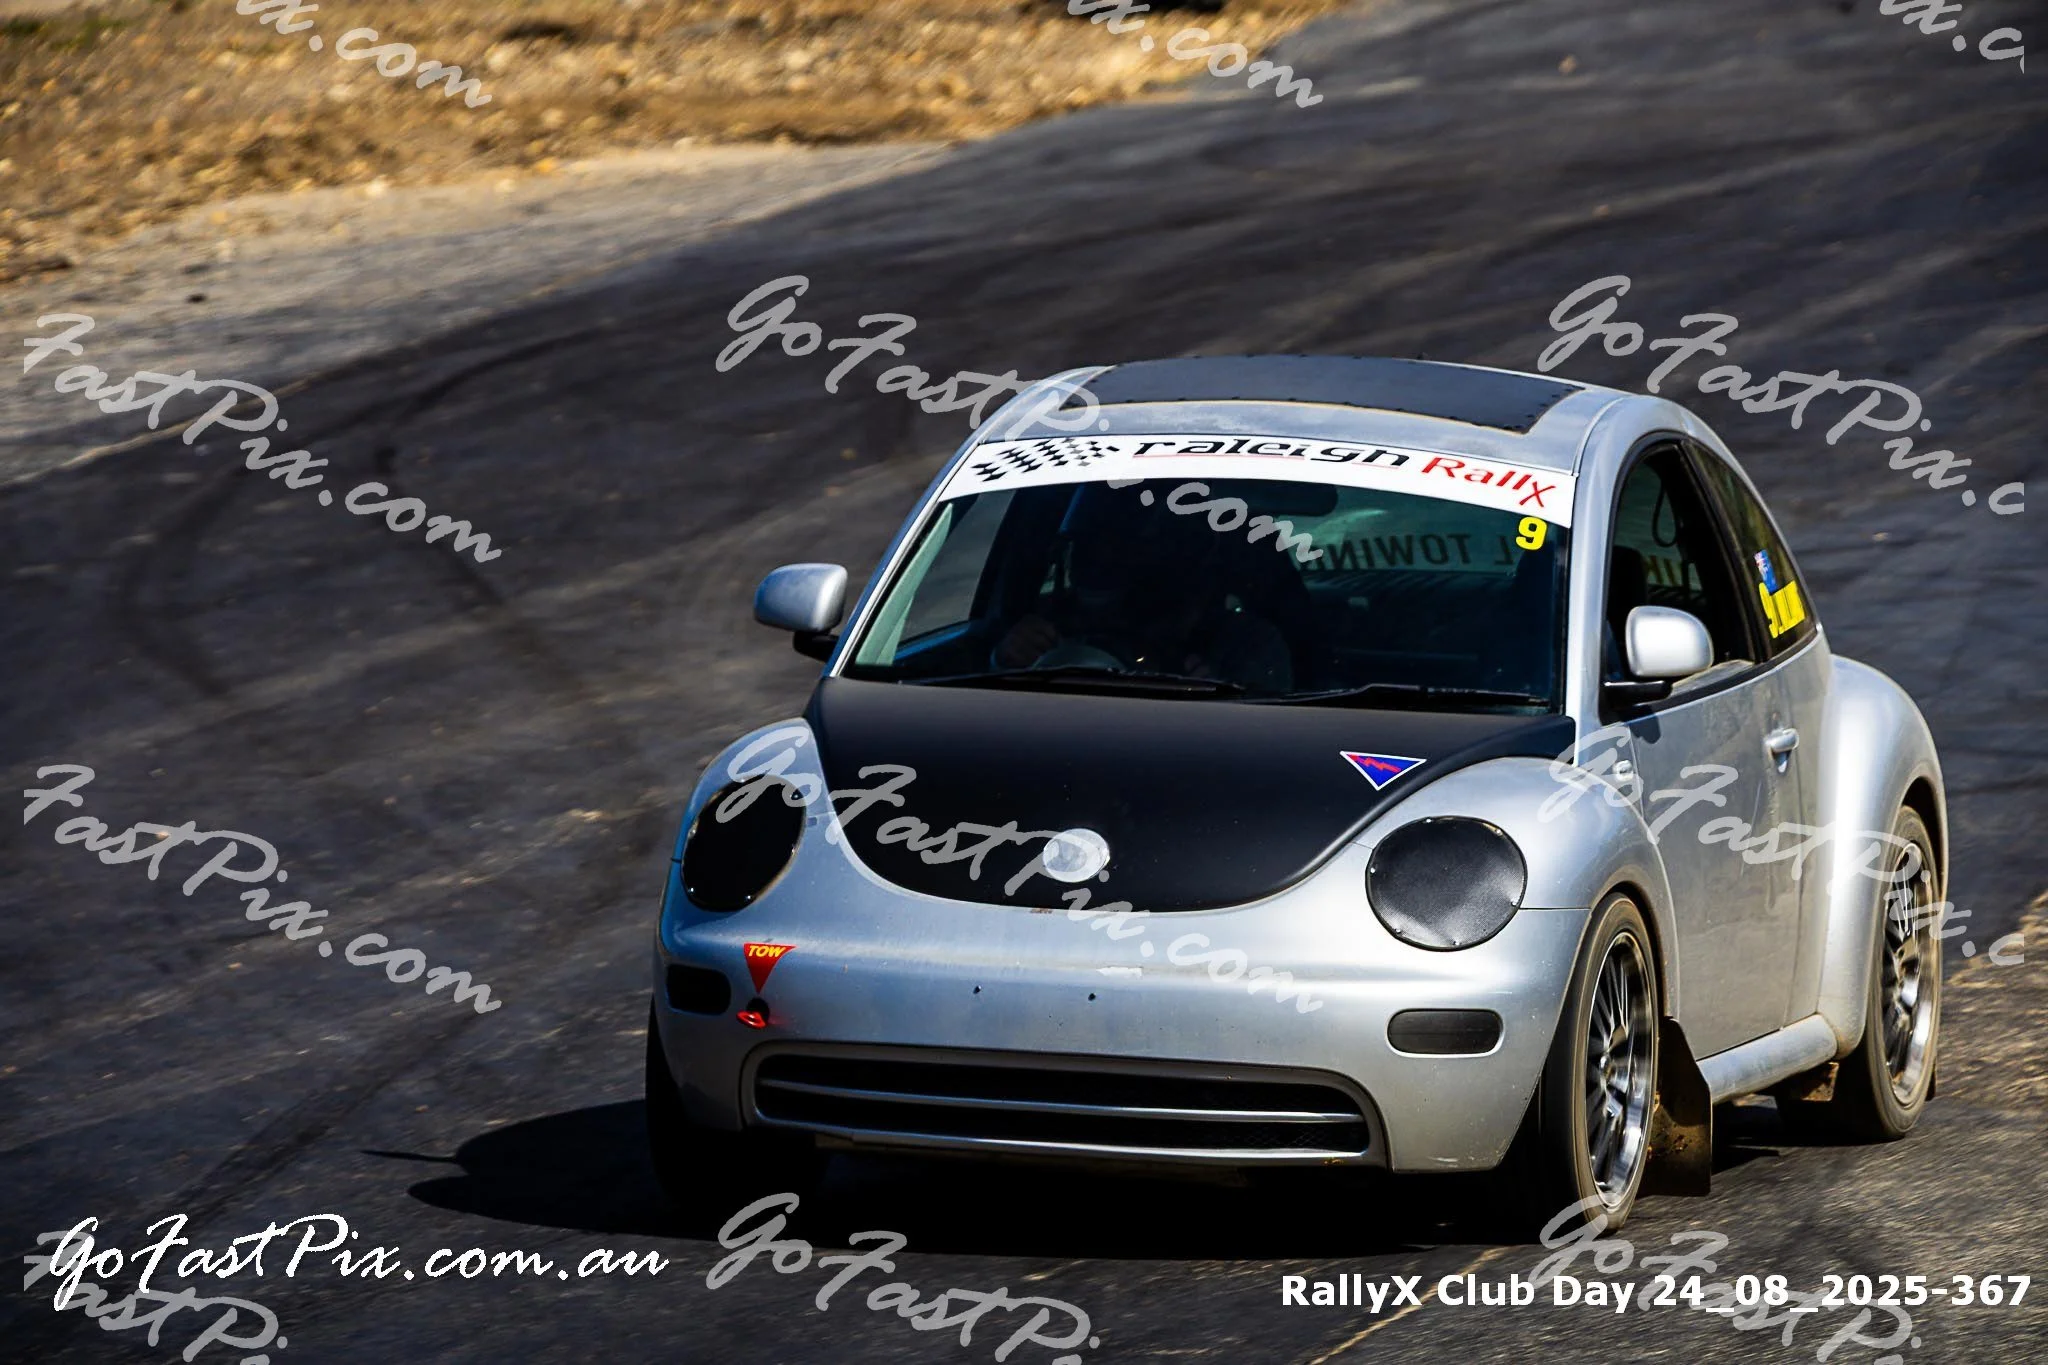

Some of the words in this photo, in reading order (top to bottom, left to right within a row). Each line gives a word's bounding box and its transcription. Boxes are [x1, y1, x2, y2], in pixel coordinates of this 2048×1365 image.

[1133, 438, 1411, 469] raleigh
[1515, 516, 1548, 550] 9
[748, 945, 786, 958] TOW
